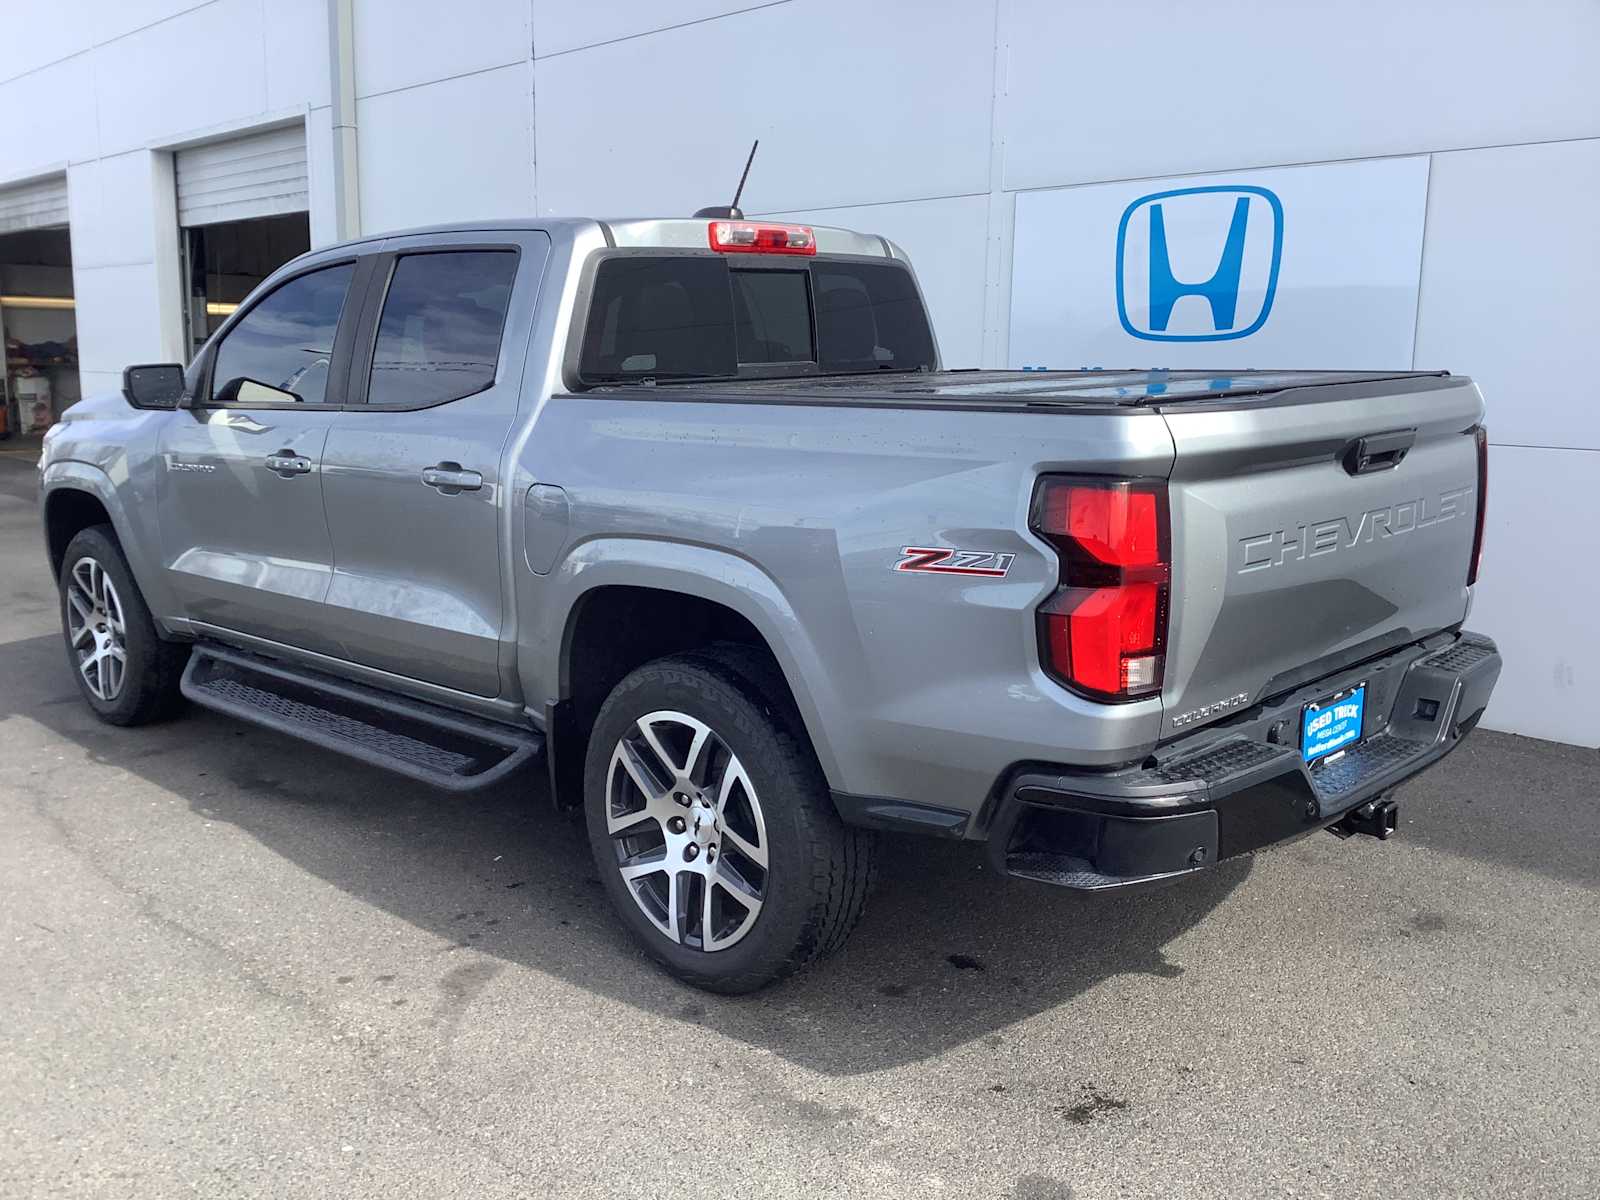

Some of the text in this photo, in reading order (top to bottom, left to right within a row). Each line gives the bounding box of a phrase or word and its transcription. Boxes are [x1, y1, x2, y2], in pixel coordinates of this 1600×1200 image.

[1237, 487, 1473, 574] CHEVROLET
[893, 545, 1016, 578] Z71
[1307, 711, 1332, 737] USED
